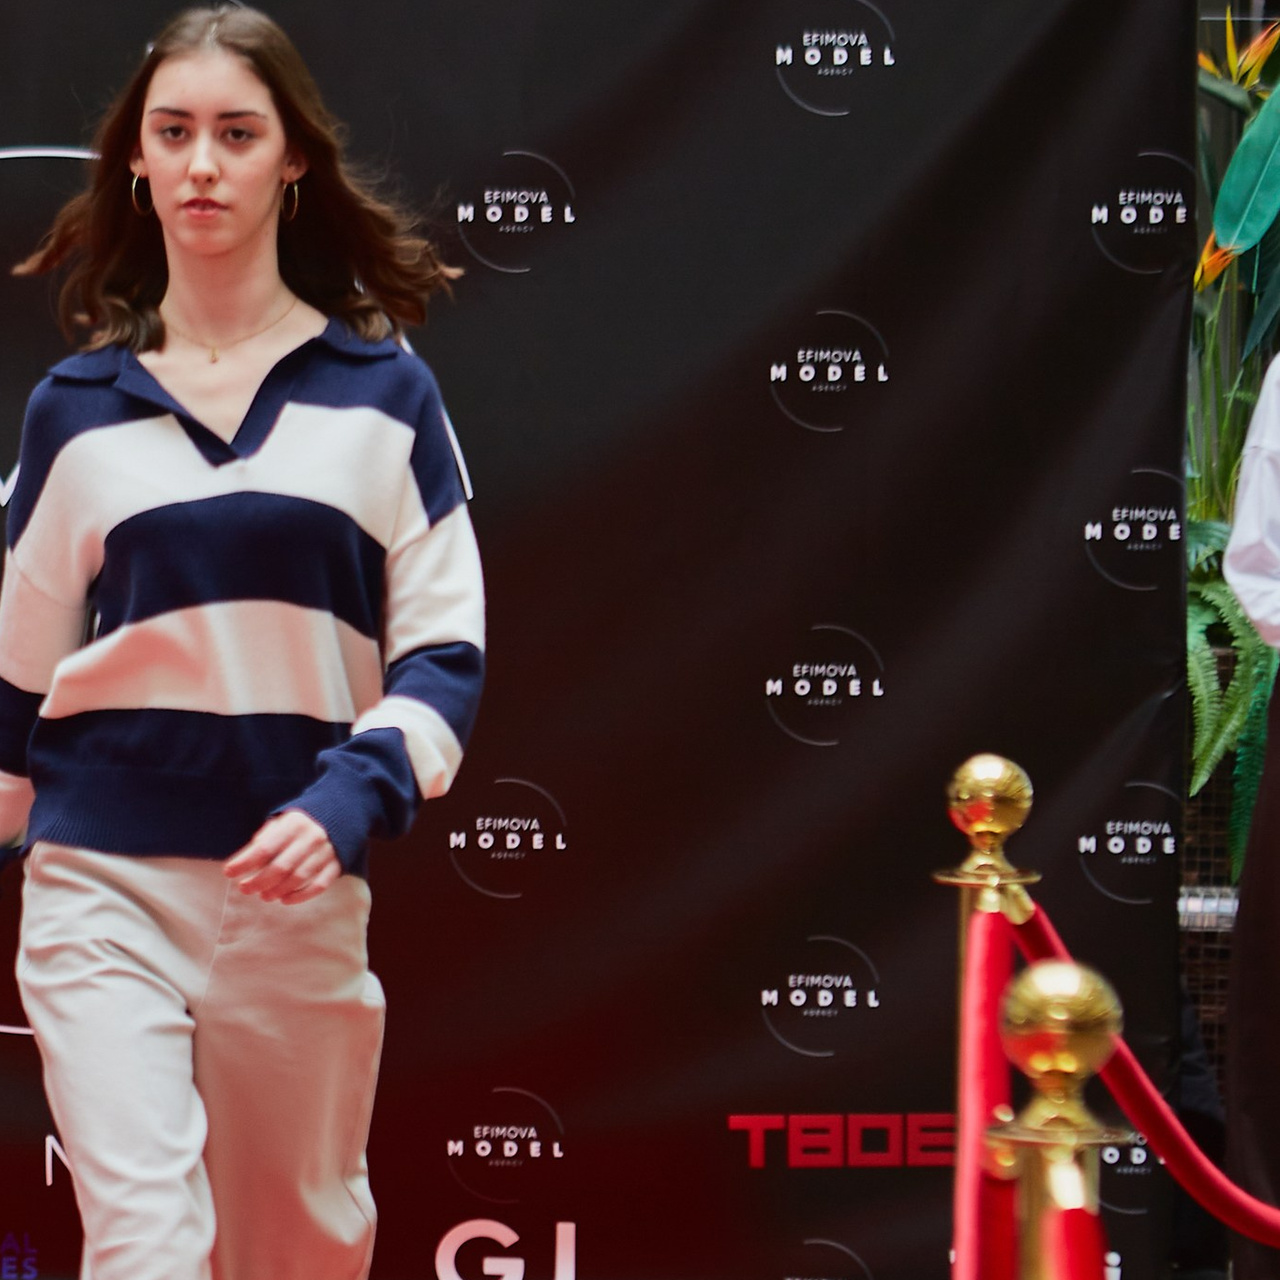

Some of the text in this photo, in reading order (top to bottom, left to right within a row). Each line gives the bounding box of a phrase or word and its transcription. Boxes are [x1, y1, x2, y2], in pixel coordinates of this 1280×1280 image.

[802, 33, 868, 47] EFIMOVA
[775, 47, 895, 66] MODEL
[484, 190, 551, 204] EFIMOVA
[1118, 191, 1183, 205] EFIMOVA
[457, 205, 576, 223] MODEL
[797, 349, 862, 363] EFIMOVA
[770, 364, 889, 382] MODEL
[1112, 508, 1177, 522] EFIMOVA
[792, 664, 857, 678] EFIMOVA
[765, 679, 884, 696] MODEL
[476, 817, 540, 831] EFIMOVA
[1106, 821, 1171, 835] EFIMOVA
[449, 832, 567, 850] MODEL
[788, 974, 853, 988] EFIMOVA
[761, 989, 880, 1008] MODEL
[473, 1125, 537, 1139] EFIMOVA
[447, 1140, 564, 1158] MODEL
